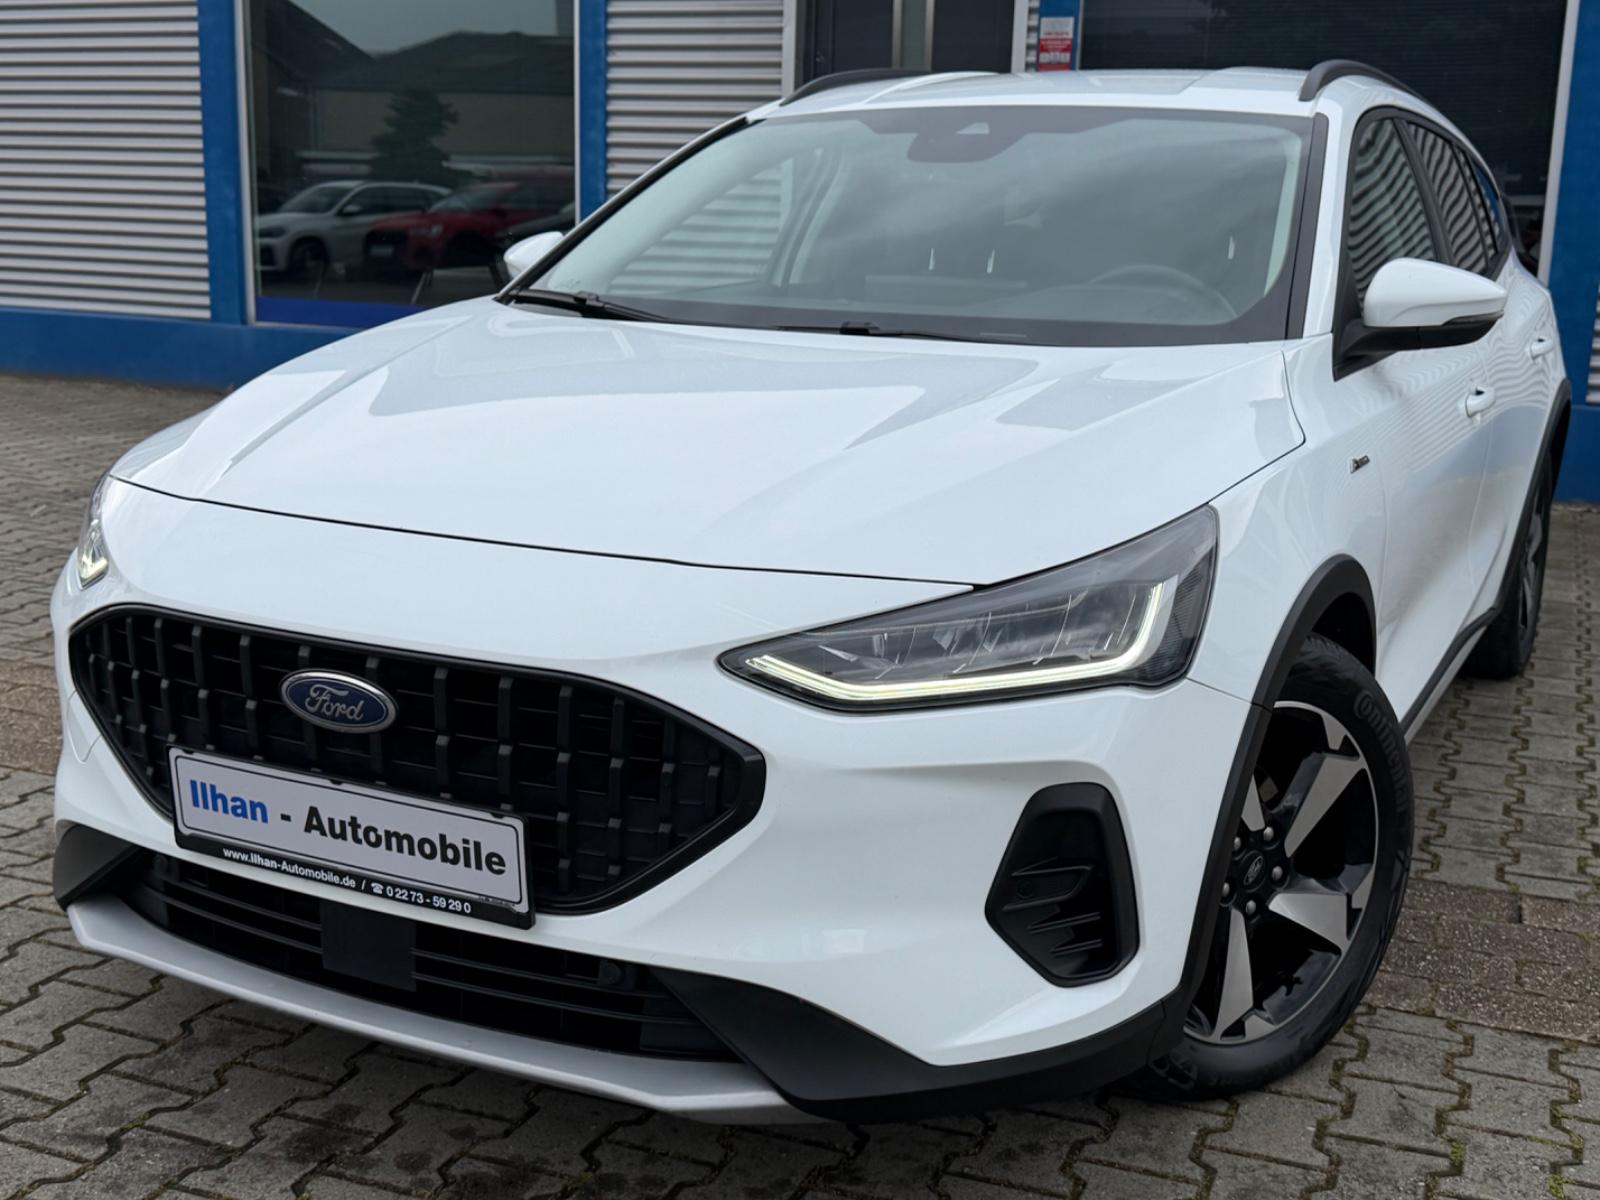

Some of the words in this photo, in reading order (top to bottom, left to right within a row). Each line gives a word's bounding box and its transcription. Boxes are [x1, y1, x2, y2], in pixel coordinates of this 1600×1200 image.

[304, 684, 365, 721] Ford
[190, 779, 269, 825] Ilhan
[280, 812, 292, 823] -
[304, 805, 507, 876] Automobile
